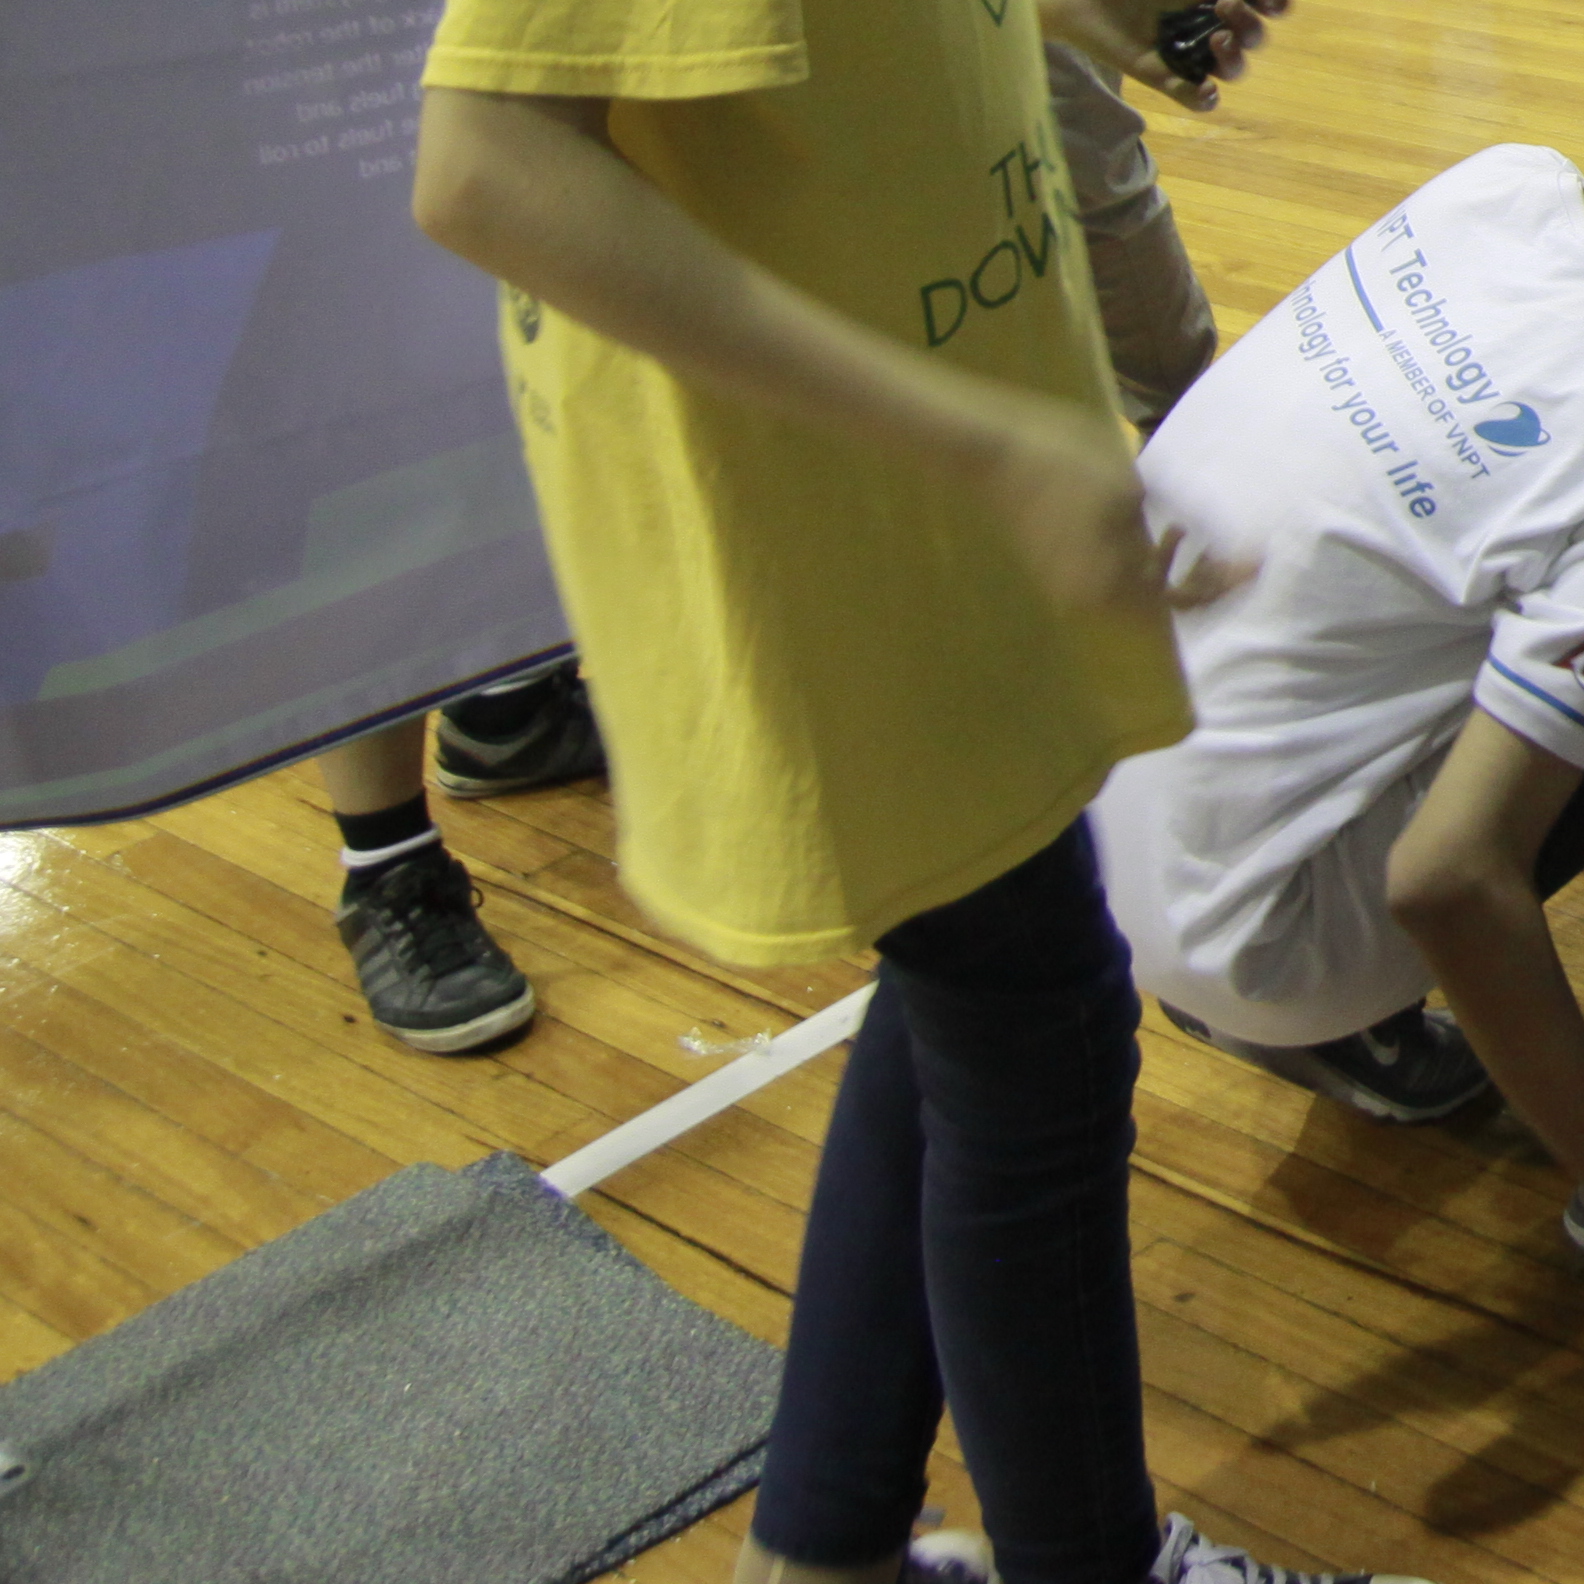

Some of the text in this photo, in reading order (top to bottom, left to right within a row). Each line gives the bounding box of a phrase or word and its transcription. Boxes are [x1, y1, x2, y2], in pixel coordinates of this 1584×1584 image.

[1389, 248, 1501, 405] Technology
[1319, 356, 1356, 391] for
[1378, 329, 1492, 480] A MEMBER OF VNPT
[1331, 391, 1401, 455] your
[1386, 459, 1437, 519] life
